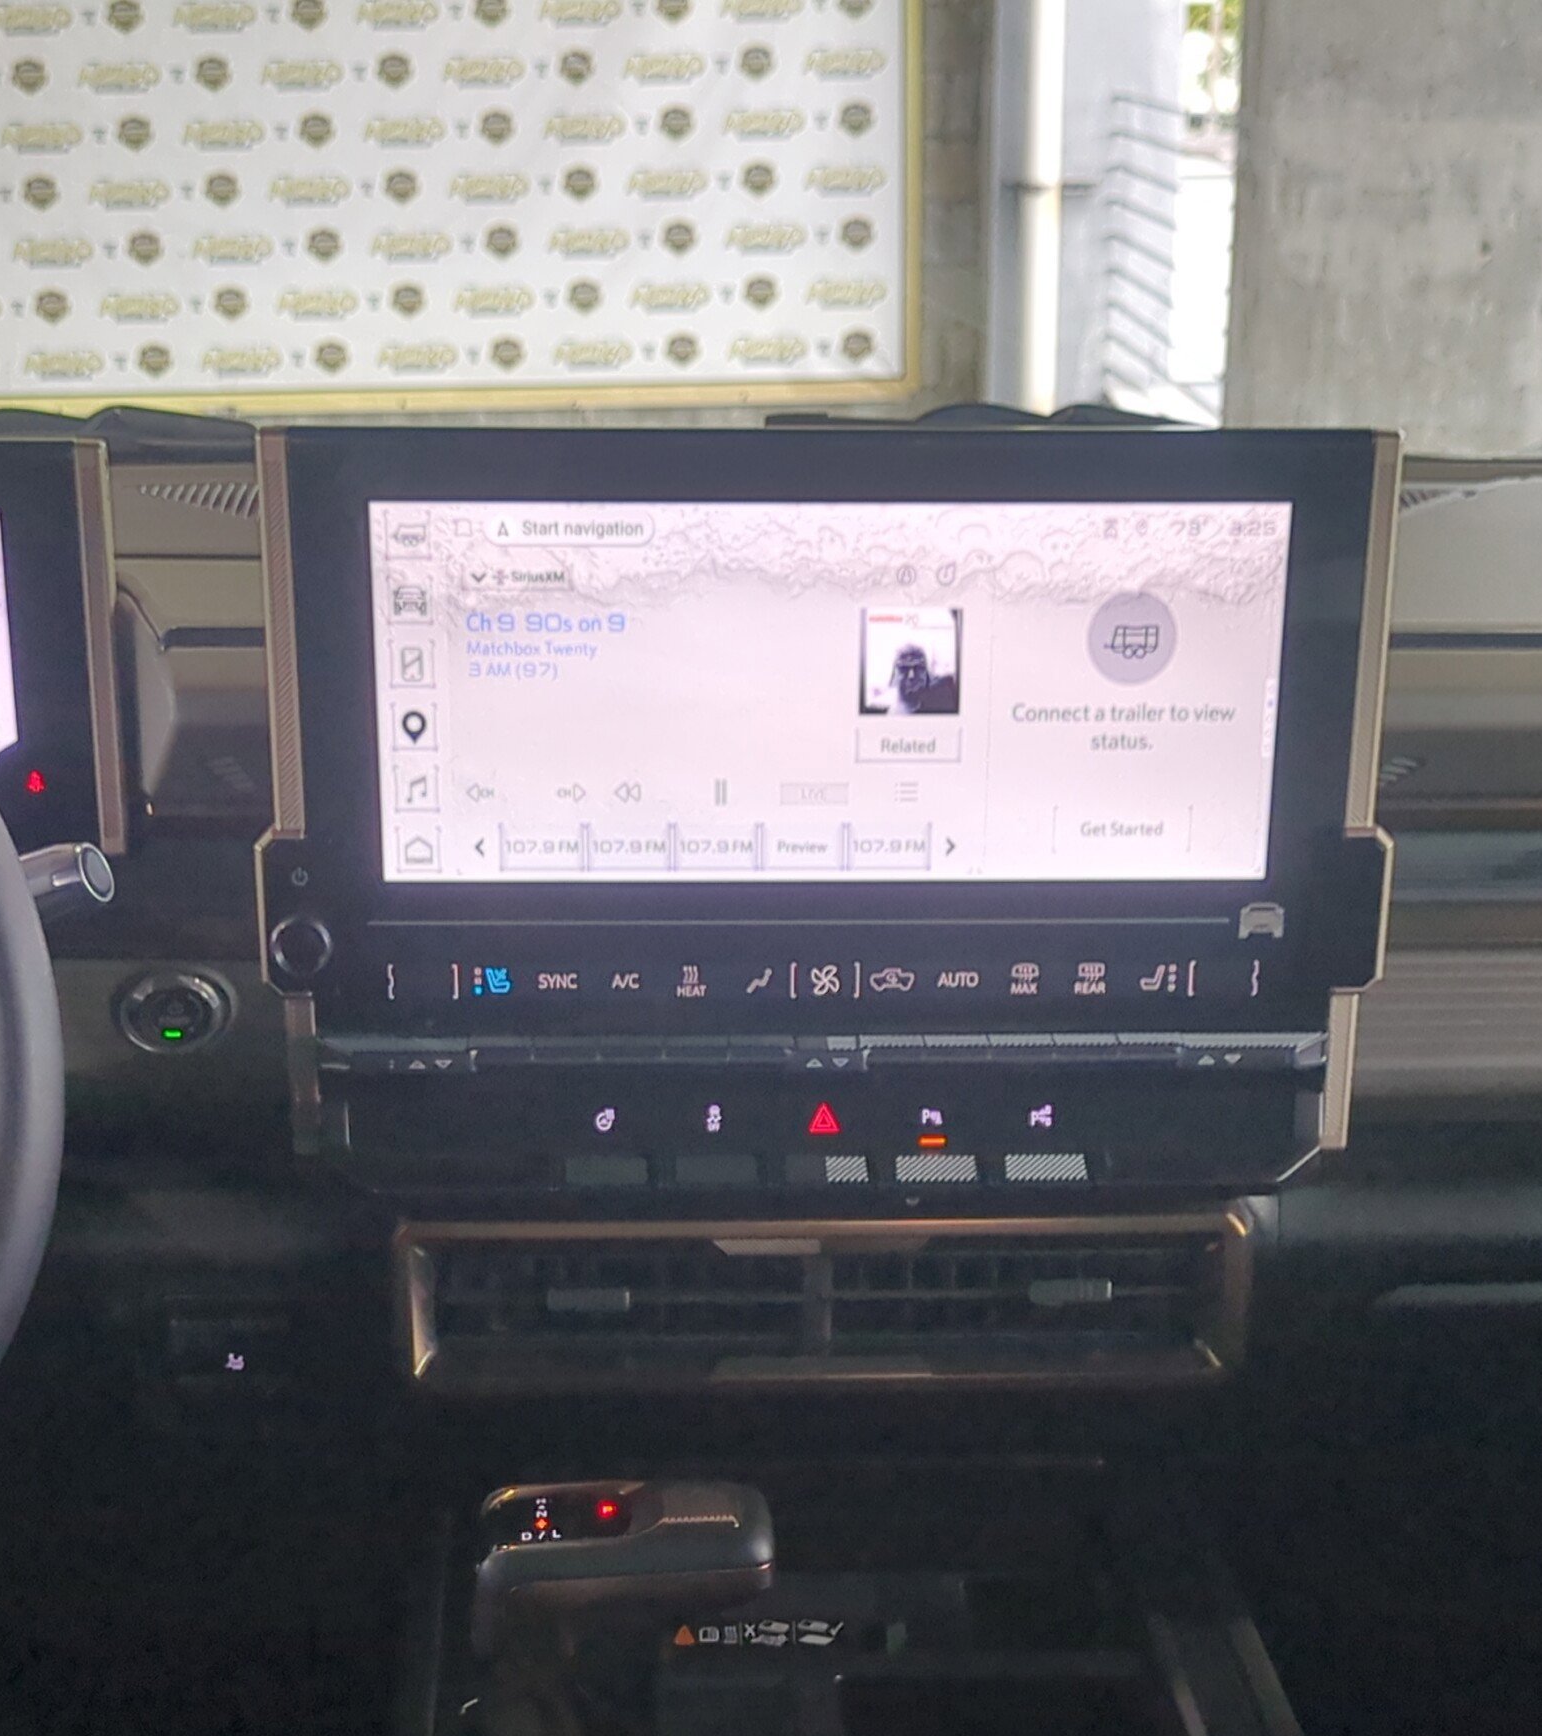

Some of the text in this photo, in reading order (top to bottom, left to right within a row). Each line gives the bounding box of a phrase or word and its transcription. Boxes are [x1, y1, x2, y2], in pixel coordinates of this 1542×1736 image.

[522, 520, 643, 539] Start navigation
[511, 571, 565, 583] SiriusXM
[466, 612, 626, 632] Ch 9 90s on 9
[466, 641, 597, 659] Matchbox Twenty
[468, 662, 559, 680] 3 AM (97)
[1011, 703, 1237, 723] Connect a trailer to view
[879, 738, 937, 754] Related
[1090, 734, 1153, 751] status.
[1079, 821, 1164, 837] Get Started
[506, 839, 580, 854] 107.9 FM
[592, 839, 666, 854] 107.9 FM
[680, 839, 754, 854] 107.9 FM
[776, 839, 828, 853] Preview
[853, 839, 926, 853] 107.9 FM
[537, 973, 578, 989] SYNC
[611, 973, 640, 989] A/C
[937, 971, 979, 988] AUTO
[676, 984, 707, 998] HEAT
[1010, 981, 1038, 995] MAX
[1074, 981, 1106, 995] REAR
